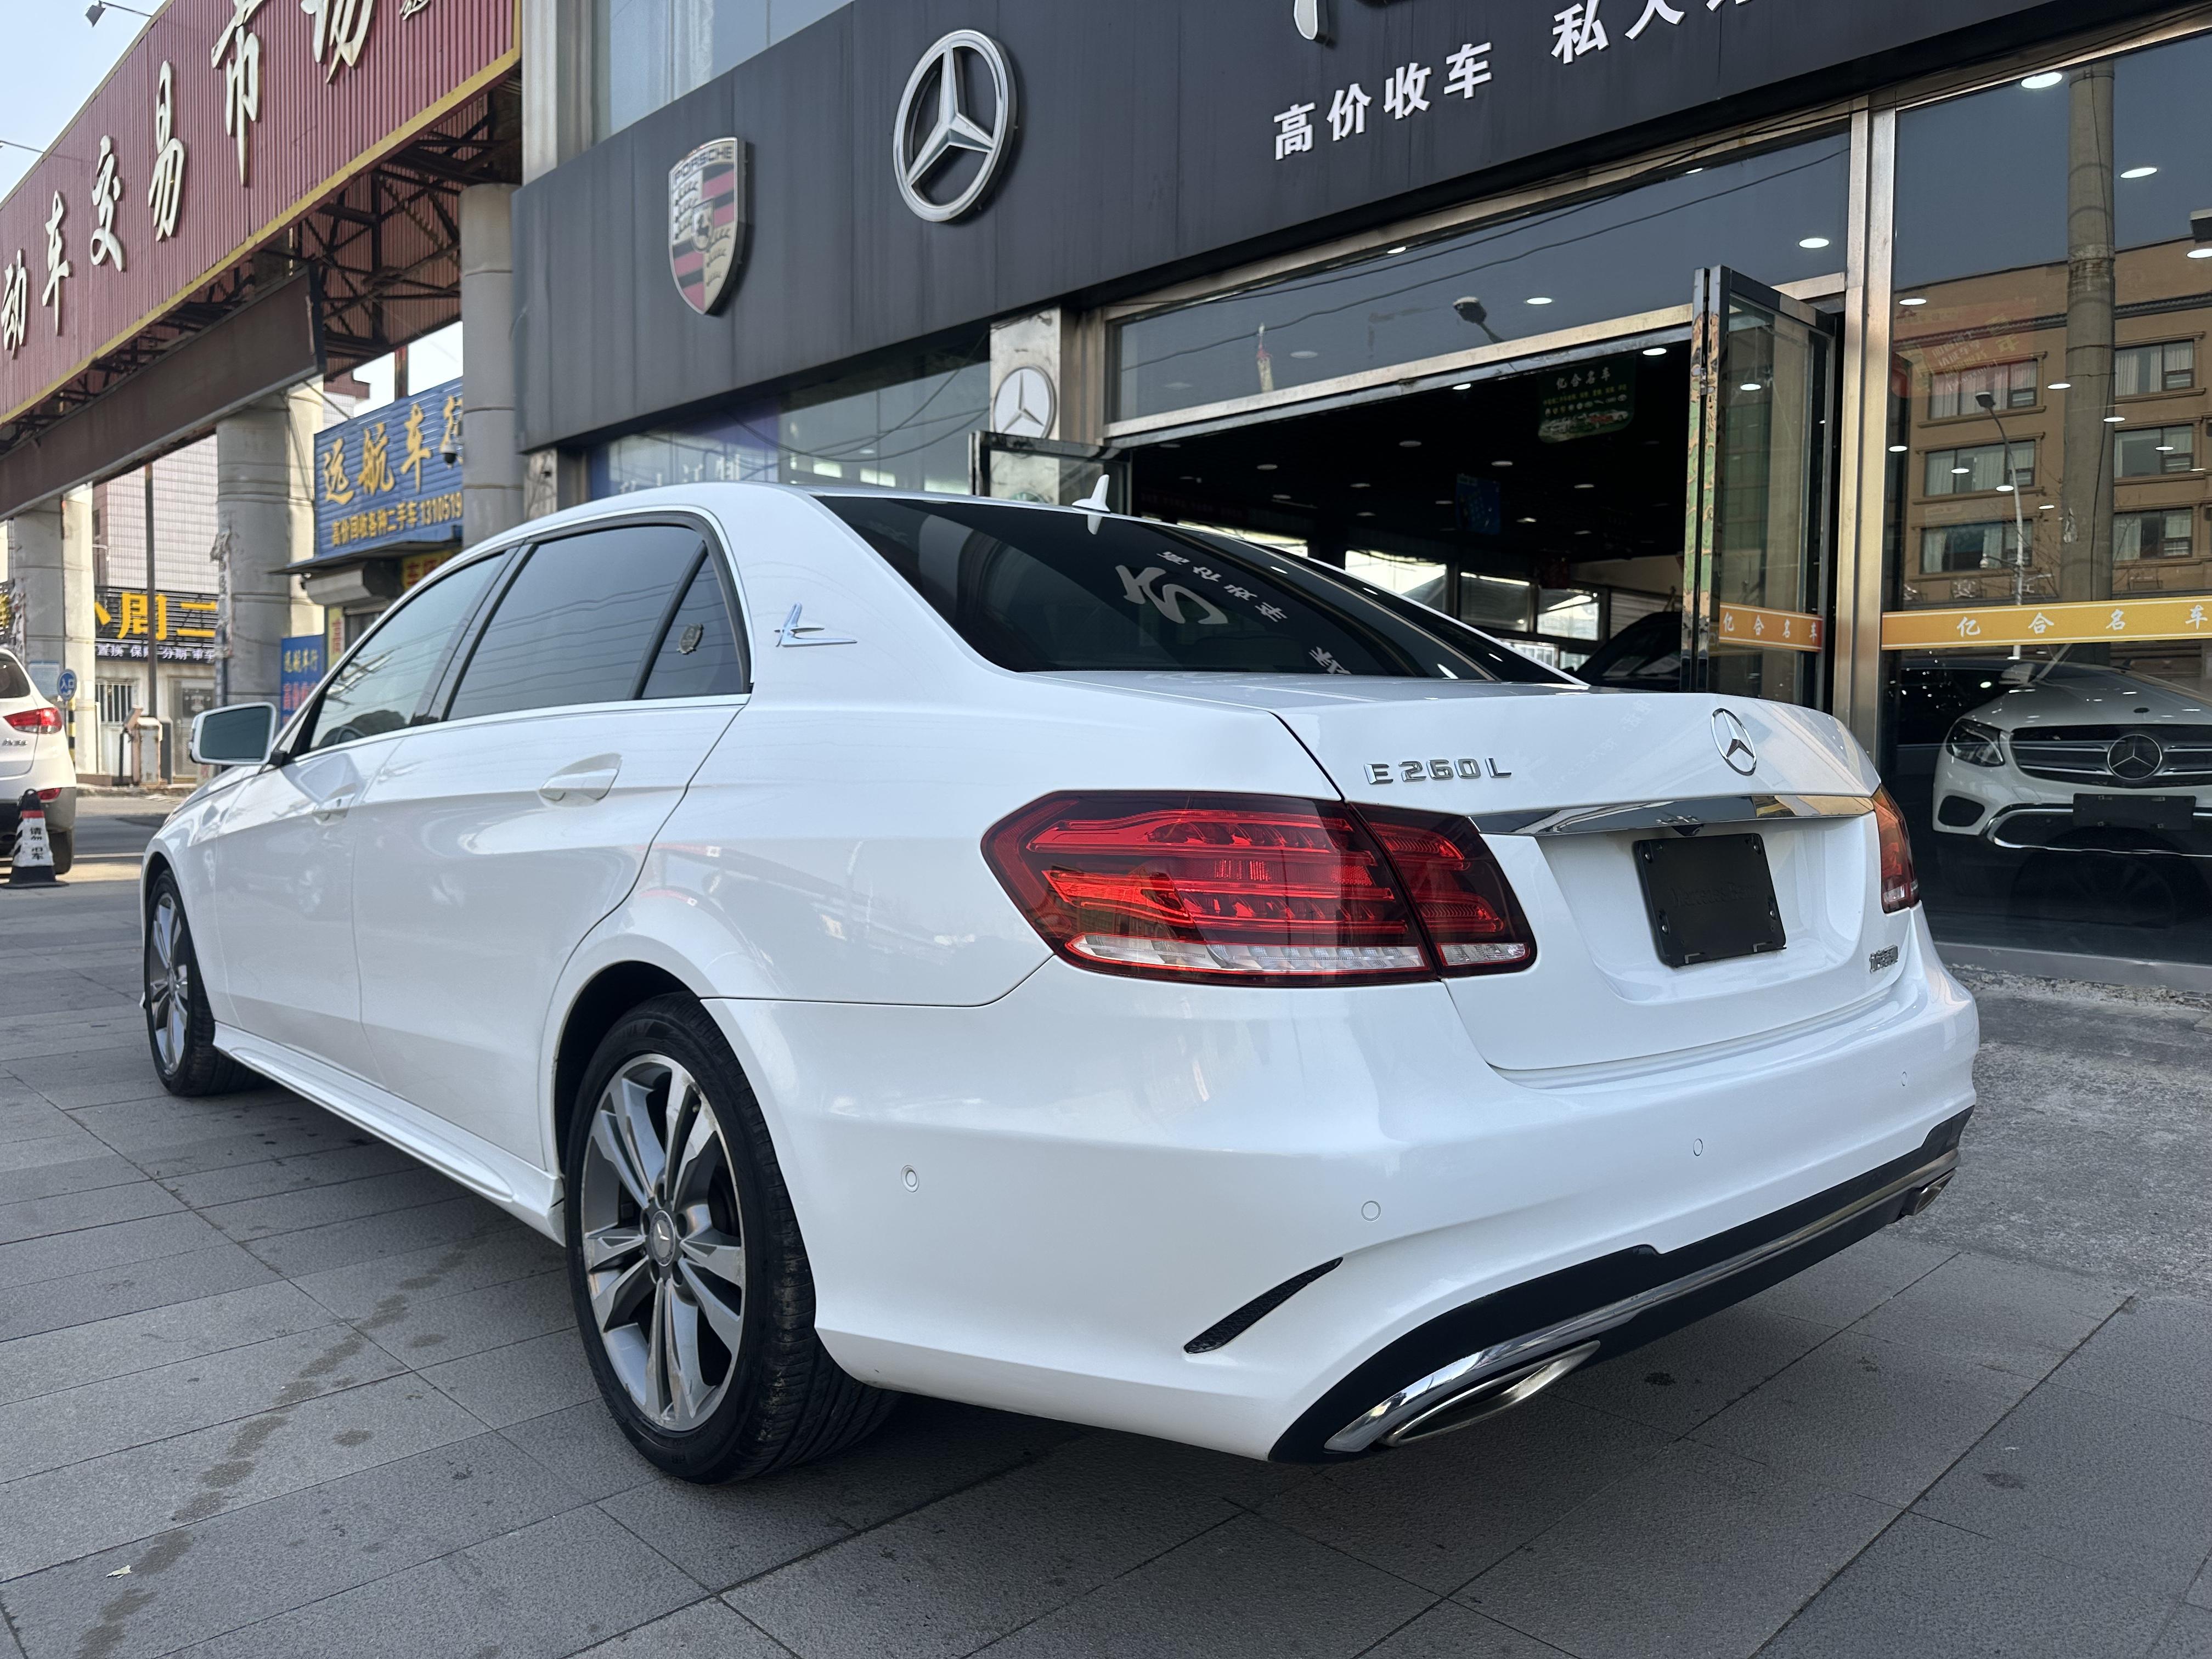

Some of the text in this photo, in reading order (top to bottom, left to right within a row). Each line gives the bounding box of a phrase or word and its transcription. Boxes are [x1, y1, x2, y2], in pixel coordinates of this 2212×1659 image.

[1274, 0, 1754, 161] 高价收车 私人
[674, 145, 733, 182] PORSCHE
[1723, 611, 1818, 644] 亿合名车
[1956, 605, 2208, 637] 亿合名车
[60, 678, 75, 690] 入口
